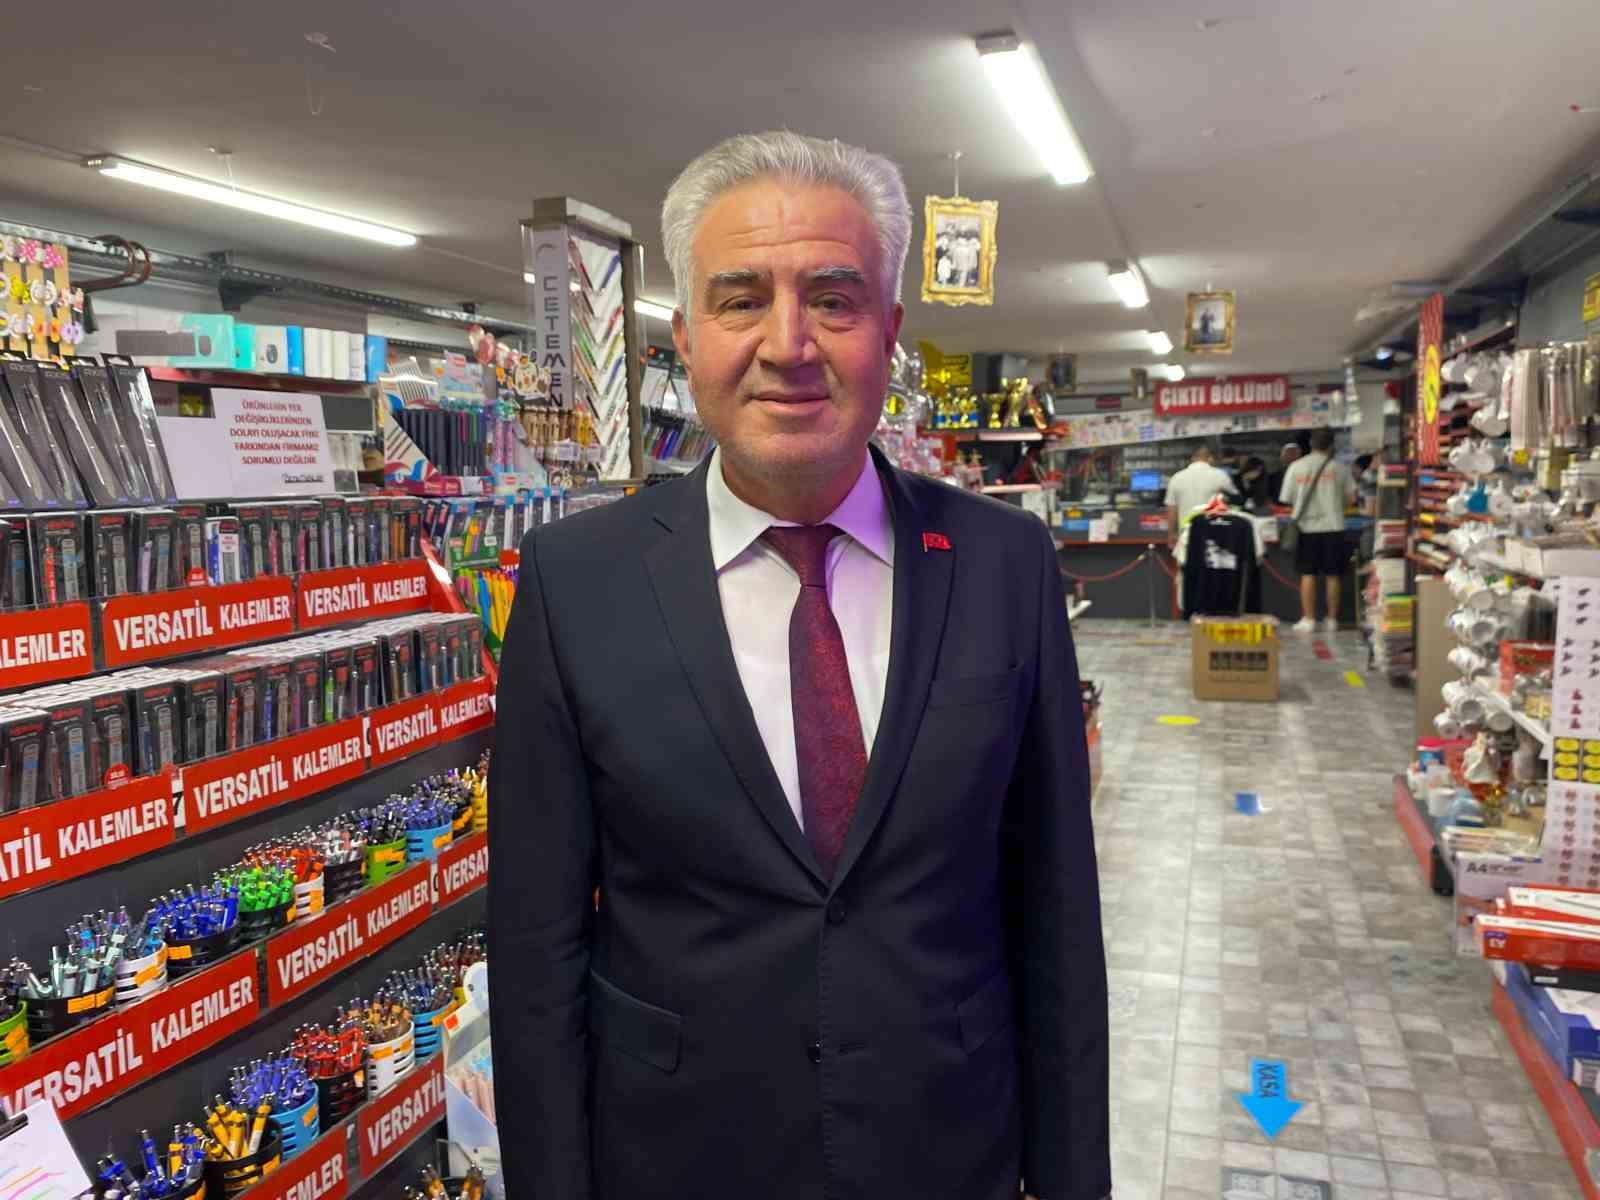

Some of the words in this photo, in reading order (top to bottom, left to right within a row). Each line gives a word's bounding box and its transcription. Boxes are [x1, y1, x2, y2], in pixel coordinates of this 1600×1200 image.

[1160, 386, 1206, 411] ÇIKTI
[1210, 376, 1286, 405] BÖLÜMÜ
[230, 428, 259, 437] DOLAYI
[261, 429, 300, 439] OLUŞACAK
[234, 442, 280, 451] FARKINDAN
[242, 456, 282, 465] SORUMLU
[113, 600, 213, 651] VERSATİL
[220, 595, 290, 630] KALEMLER
[304, 576, 370, 618] VERSATİL
[373, 576, 428, 604] KALEMLER
[376, 703, 437, 753] VERSATİL
[441, 692, 491, 729] KALEMLER
[193, 754, 289, 818] VERSATİL
[293, 736, 361, 781] KALEMLER
[58, 798, 169, 859] KALEMLER
[1467, 862, 1488, 873] A4
[277, 914, 363, 989] VERSATİL
[367, 879, 430, 936] KALEMLER
[2, 1028, 143, 1118] VERSATİL
[151, 975, 254, 1053] KALEMLER
[367, 1071, 445, 1157] VERSATİL
